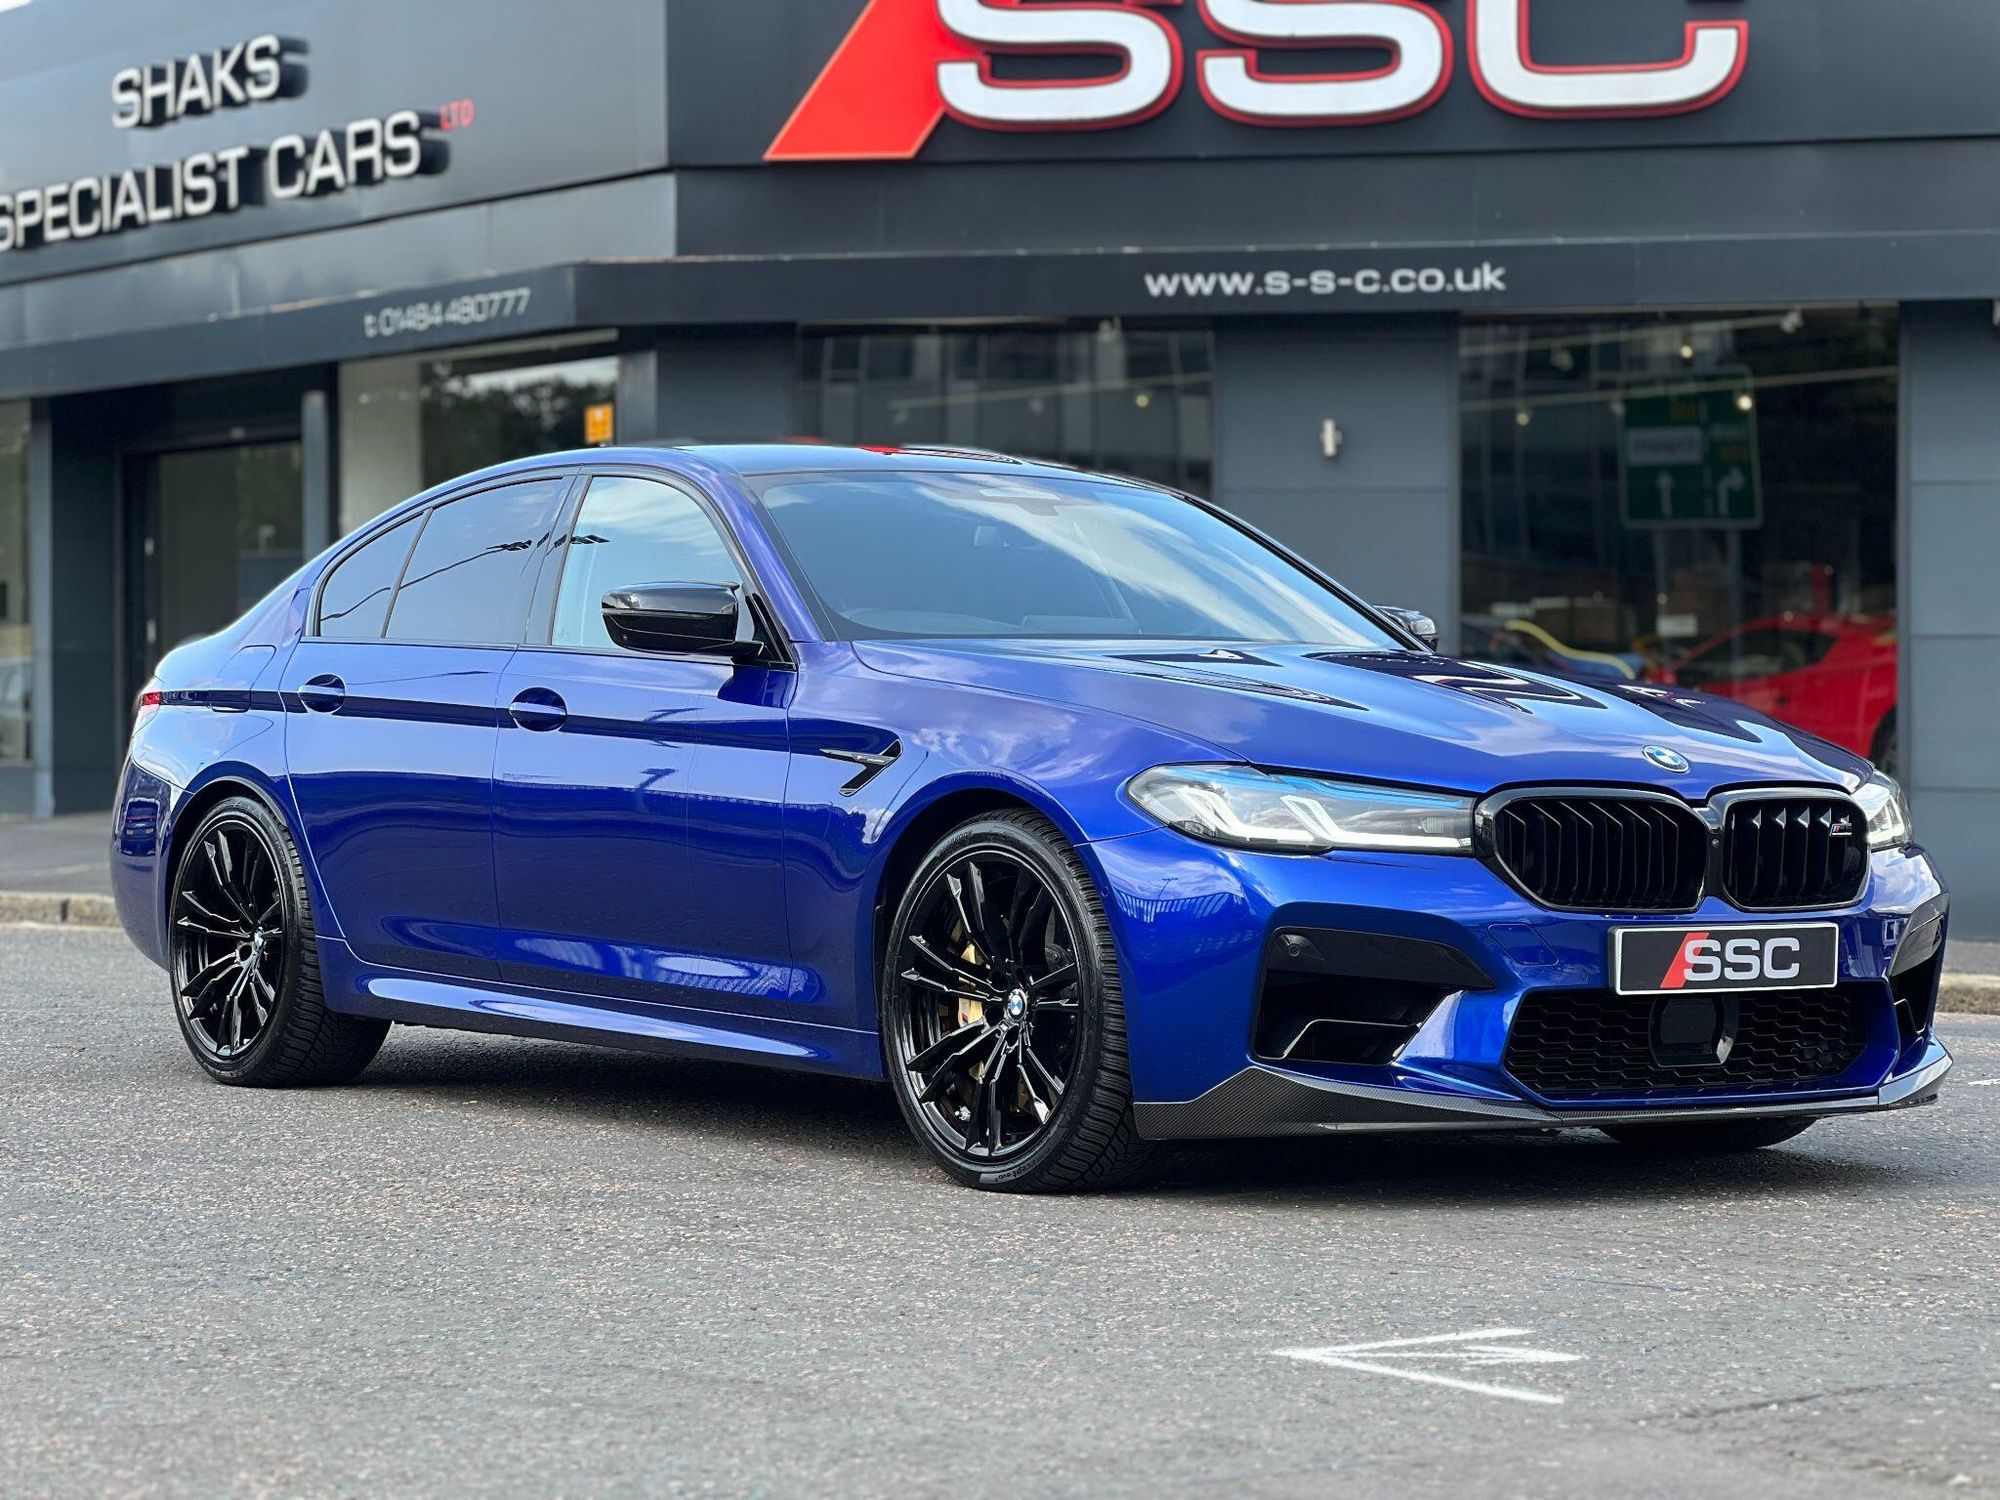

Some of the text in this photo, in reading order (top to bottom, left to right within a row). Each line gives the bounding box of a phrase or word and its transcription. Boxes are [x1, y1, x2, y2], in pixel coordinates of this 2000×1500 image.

[111, 34, 281, 129] SHAKS
[268, 109, 421, 199] CARS
[440, 98, 475, 132] LTD
[1145, 261, 1506, 297] www.s-s-c.co.uk
[1684, 937, 1800, 981] SSC
